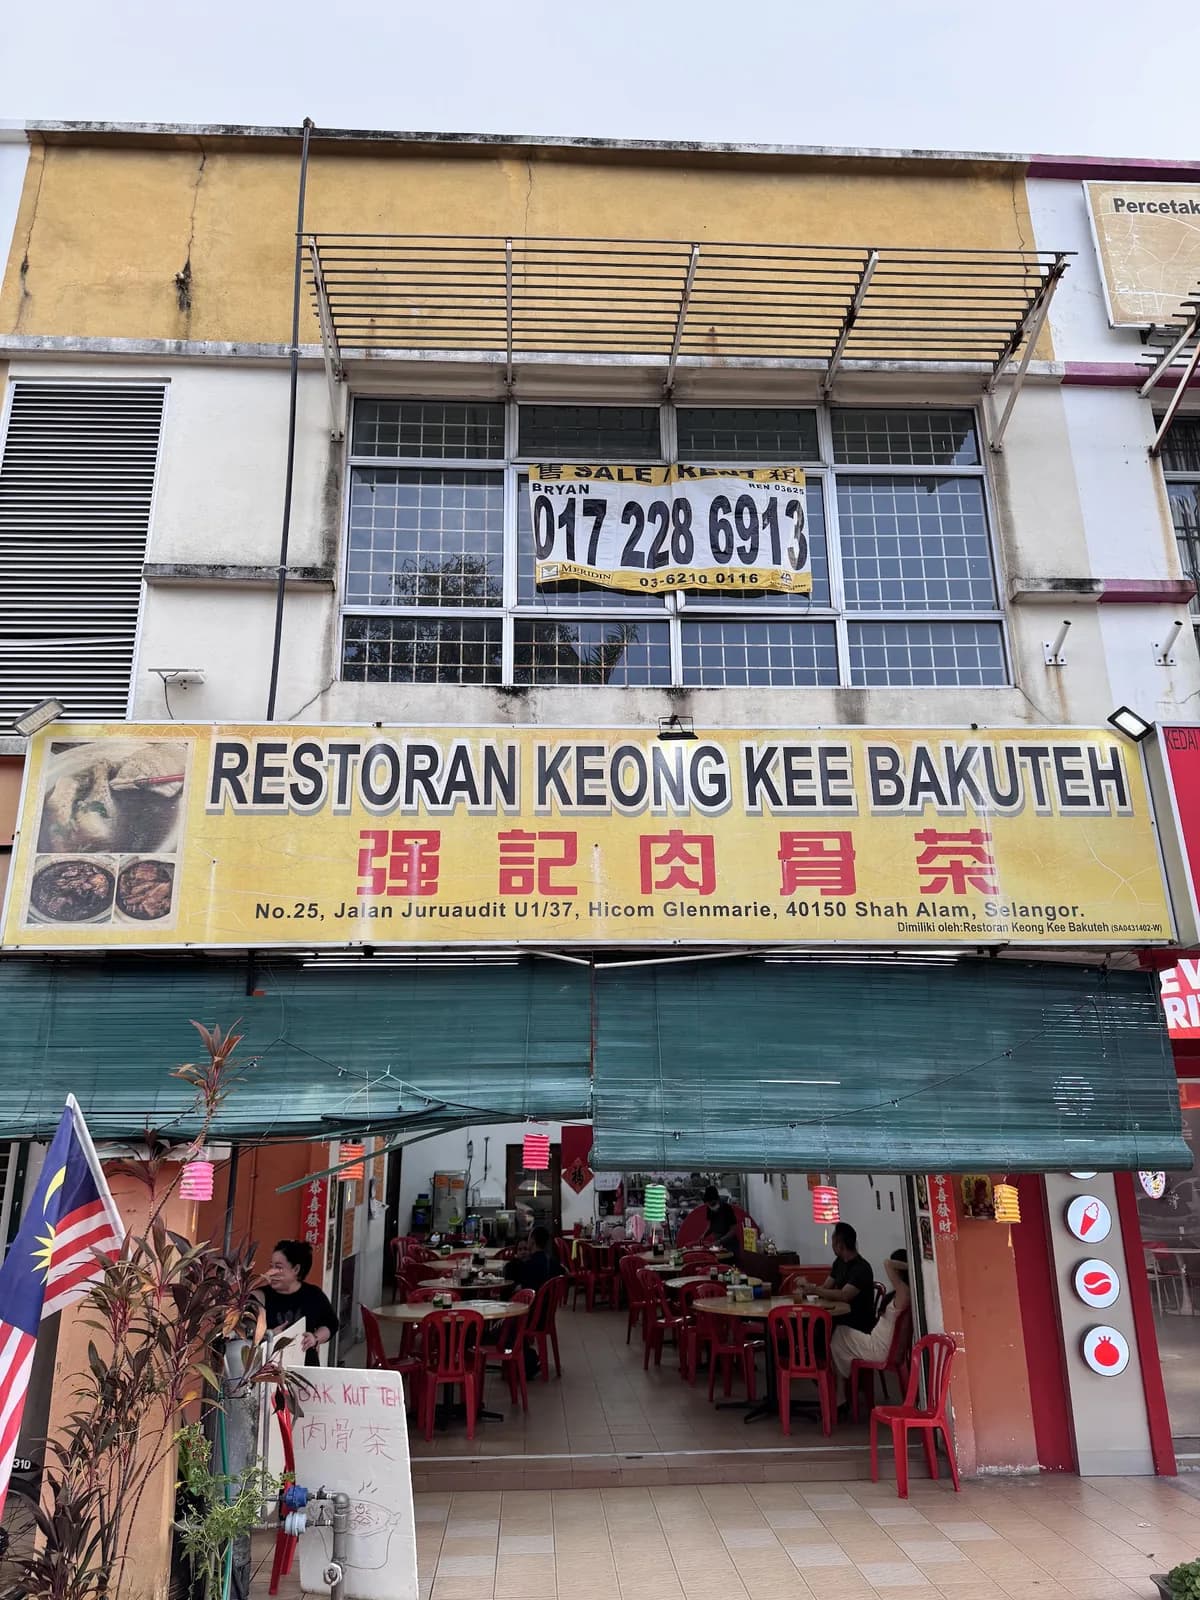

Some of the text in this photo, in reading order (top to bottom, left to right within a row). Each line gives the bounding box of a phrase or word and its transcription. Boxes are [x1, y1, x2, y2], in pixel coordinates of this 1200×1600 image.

[574, 465, 653, 484] SALE
[532, 483, 590, 496] BRYAN
[534, 494, 808, 572] 017 228 6913
[561, 563, 612, 582] MERIDIN
[639, 573, 708, 588] 03-6210
[715, 573, 759, 584] 0116
[209, 741, 1128, 808] RESTORAN KEONG KEE BAKUTEH
[254, 900, 1086, 922] No.25, Jalan Juruaudit U1/37, Hicom Glenmarie, 40150 Shah Alam, Selangor.
[897, 921, 936, 933] Dimiliki
[1011, 921, 1044, 935] Keong
[1046, 921, 1067, 933] Kee
[1069, 921, 1110, 933] Bakuteh
[1163, 994, 1200, 1030] RI
[342, 1383, 370, 1407] KUT
